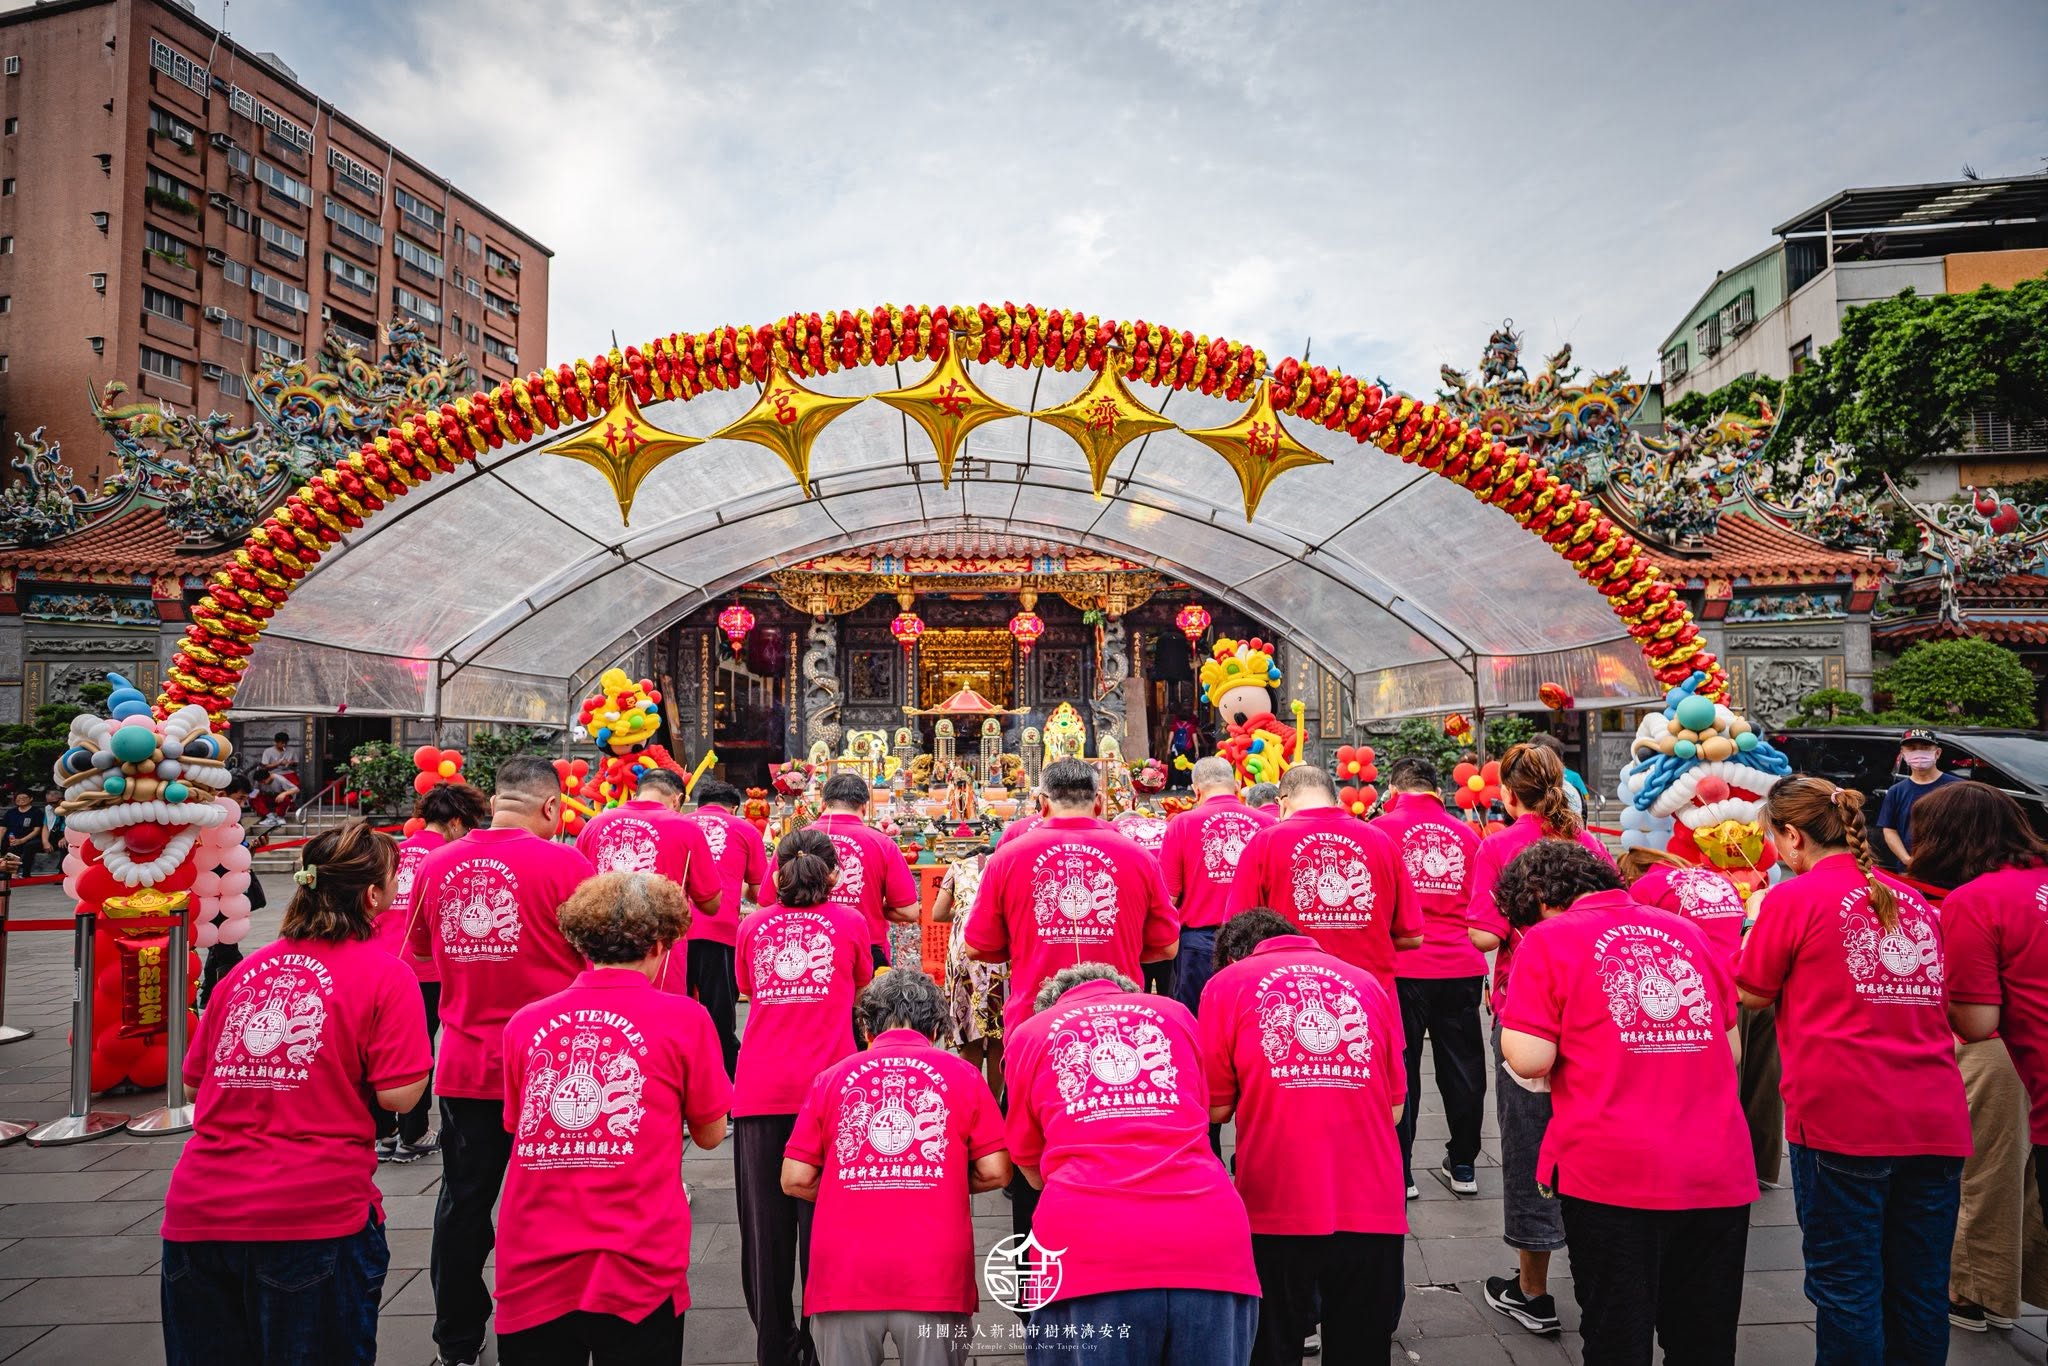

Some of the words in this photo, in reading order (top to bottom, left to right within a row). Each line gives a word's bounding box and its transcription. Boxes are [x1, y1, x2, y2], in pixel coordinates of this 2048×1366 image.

[767, 388, 799, 425] 宮
[932, 378, 972, 419] 安
[1085, 395, 1124, 437] 濟
[603, 417, 648, 456] 林
[1245, 421, 1282, 462] 樹
[623, 817, 658, 837] TEMPLE
[1422, 823, 1462, 842] TEMPLE
[1062, 844, 1113, 866] TEMPLE
[1316, 833, 1364, 854] TEMPLE
[471, 859, 516, 884] TEMPLE
[785, 912, 833, 929] TEMPLE
[1617, 924, 1685, 952] TEMPLE
[283, 954, 333, 988] TEMPLE
[1288, 964, 1355, 990] TEMPLE
[1084, 1004, 1156, 1017] TEMPLE
[575, 1010, 644, 1047] TEMPLE
[881, 1058, 944, 1085] TEMPLE
